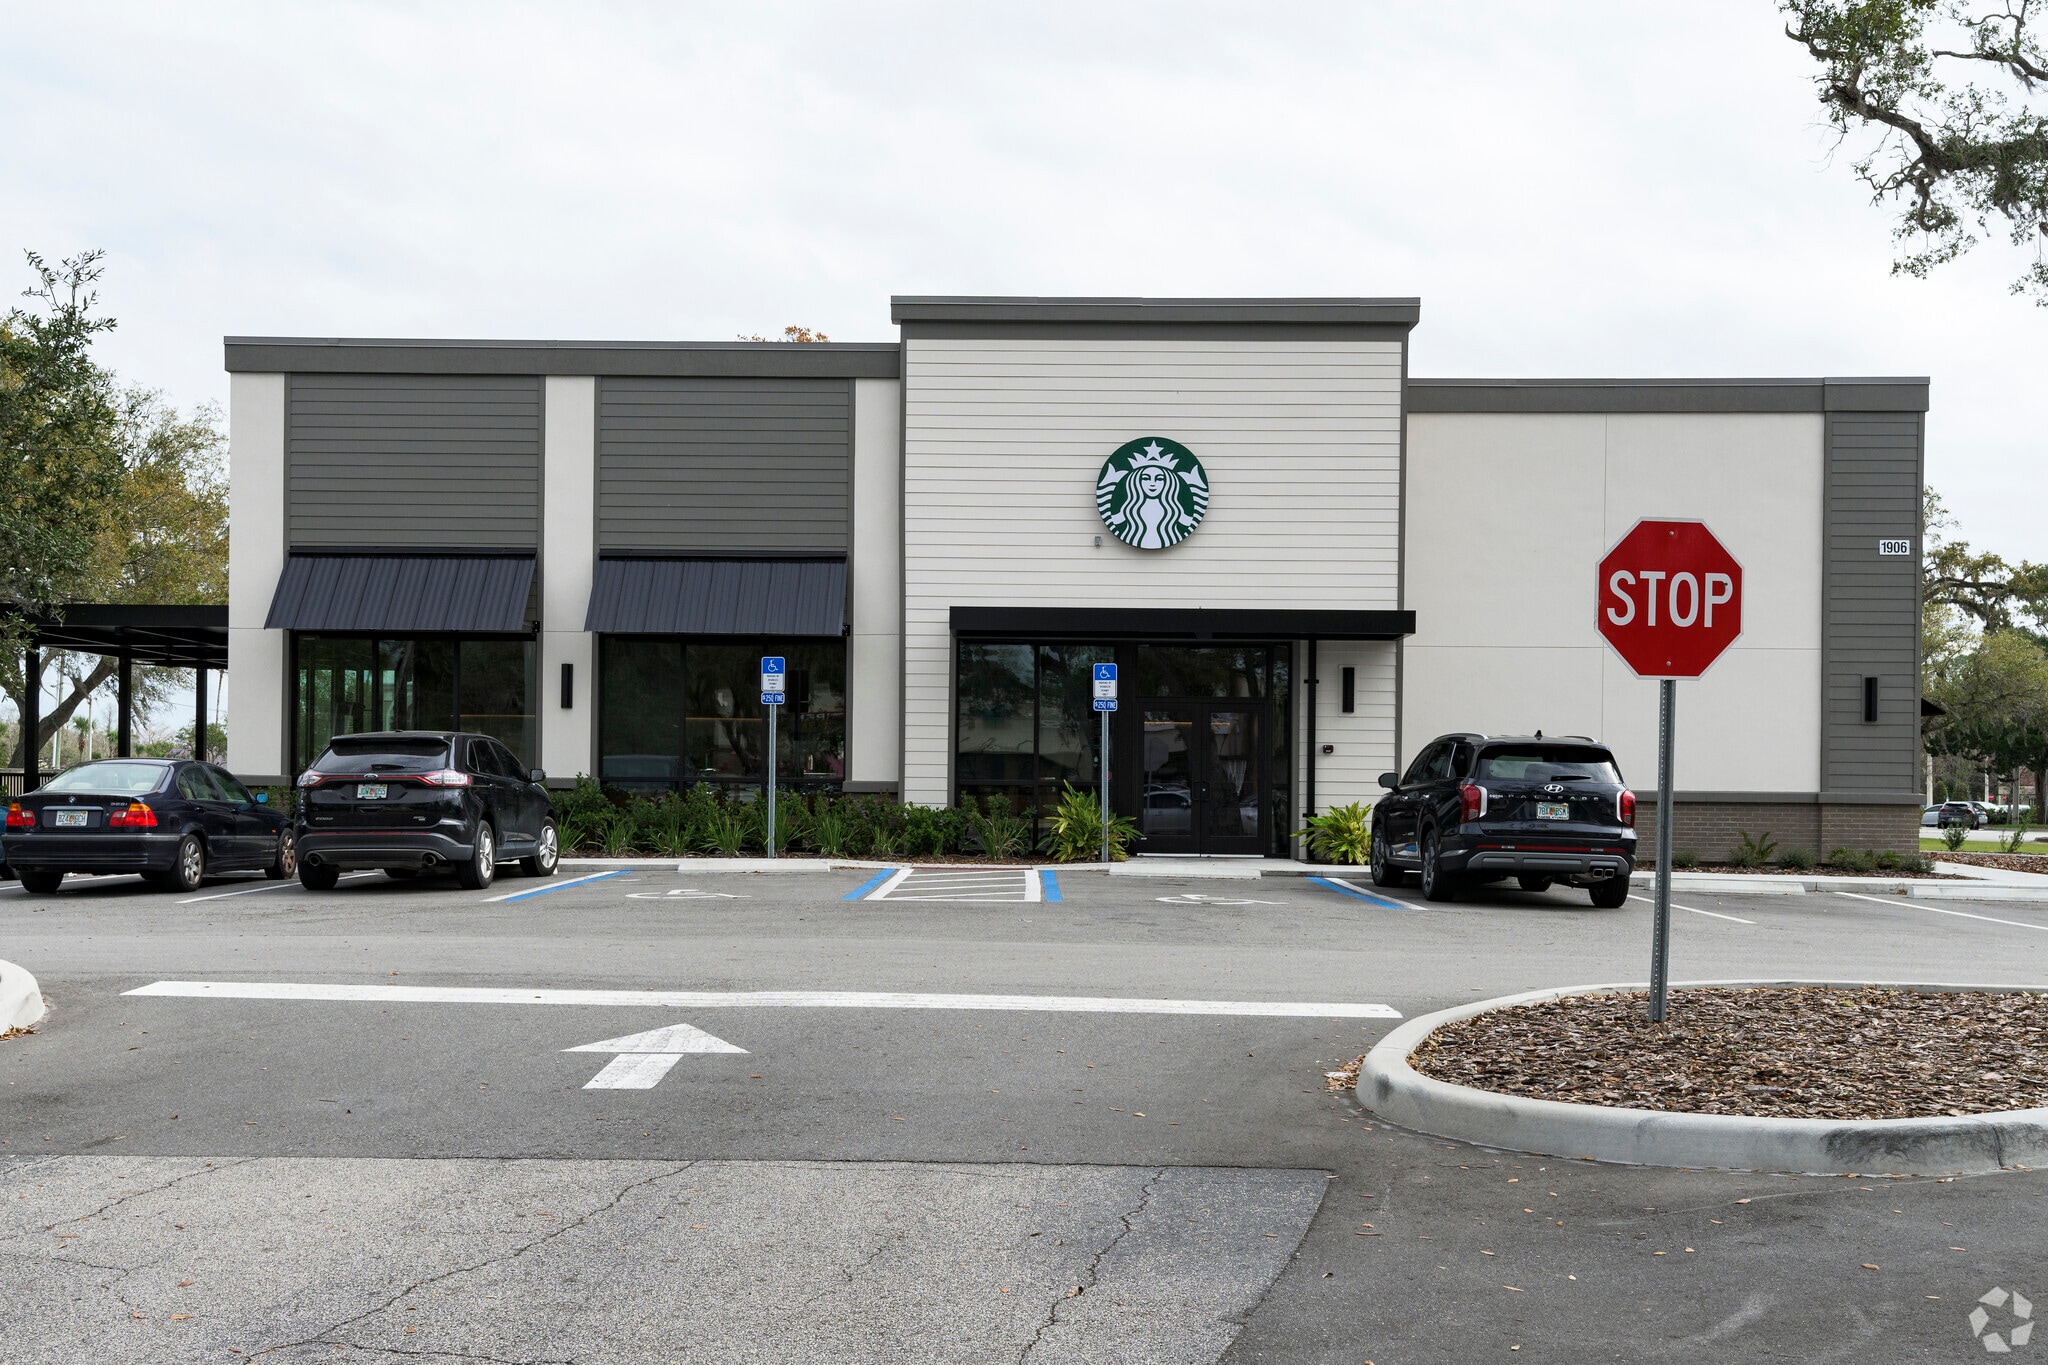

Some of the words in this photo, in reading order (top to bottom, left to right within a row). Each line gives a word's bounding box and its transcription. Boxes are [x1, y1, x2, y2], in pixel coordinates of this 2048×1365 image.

[1881, 541, 1907, 553] 1906
[1606, 570, 1733, 627] STOP
[762, 694, 774, 702] $250
[775, 694, 784, 702] FINE
[1095, 701, 1106, 709] $250
[1107, 701, 1116, 709] FINE
